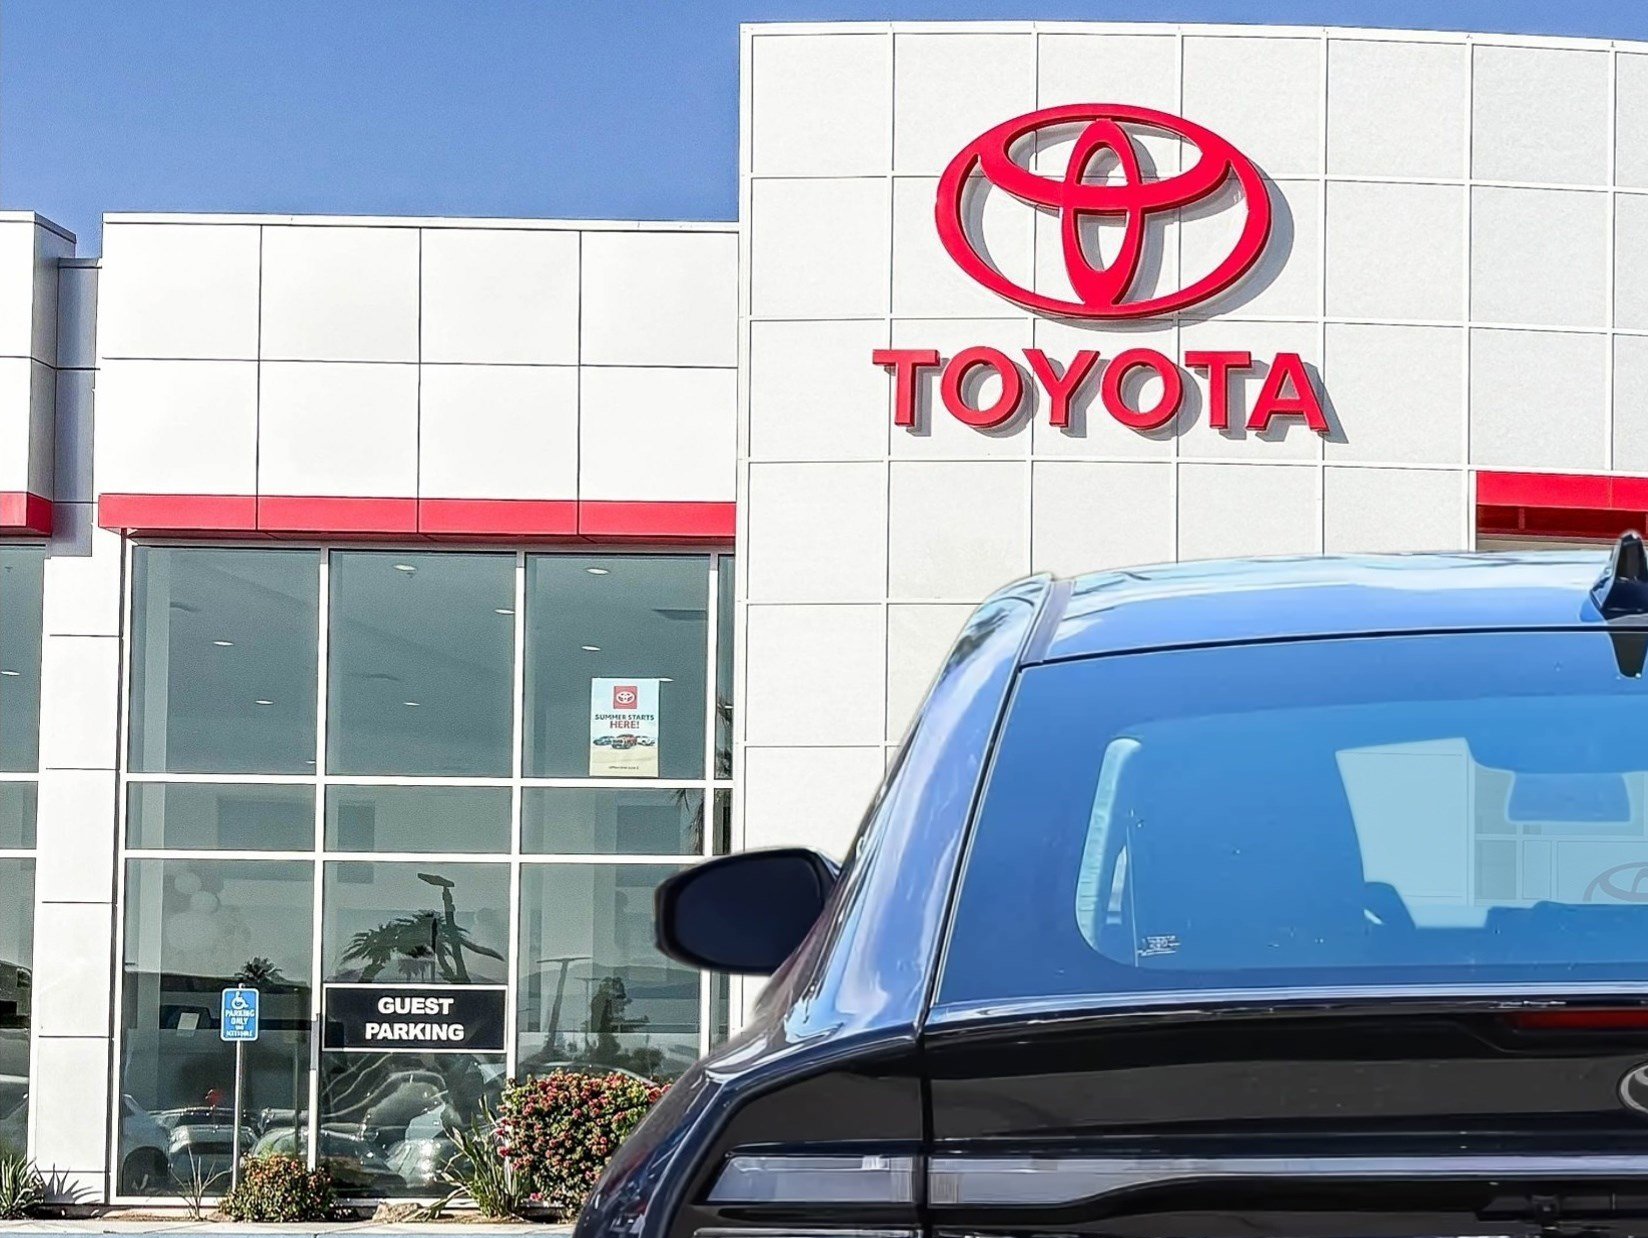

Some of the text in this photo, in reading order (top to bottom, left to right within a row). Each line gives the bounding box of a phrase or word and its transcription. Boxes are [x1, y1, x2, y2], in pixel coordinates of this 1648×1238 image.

[872, 346, 1330, 432] TOYOTA
[609, 720, 640, 729] HERE!
[377, 997, 454, 1015] GUEST
[364, 1022, 465, 1041] PARKING
